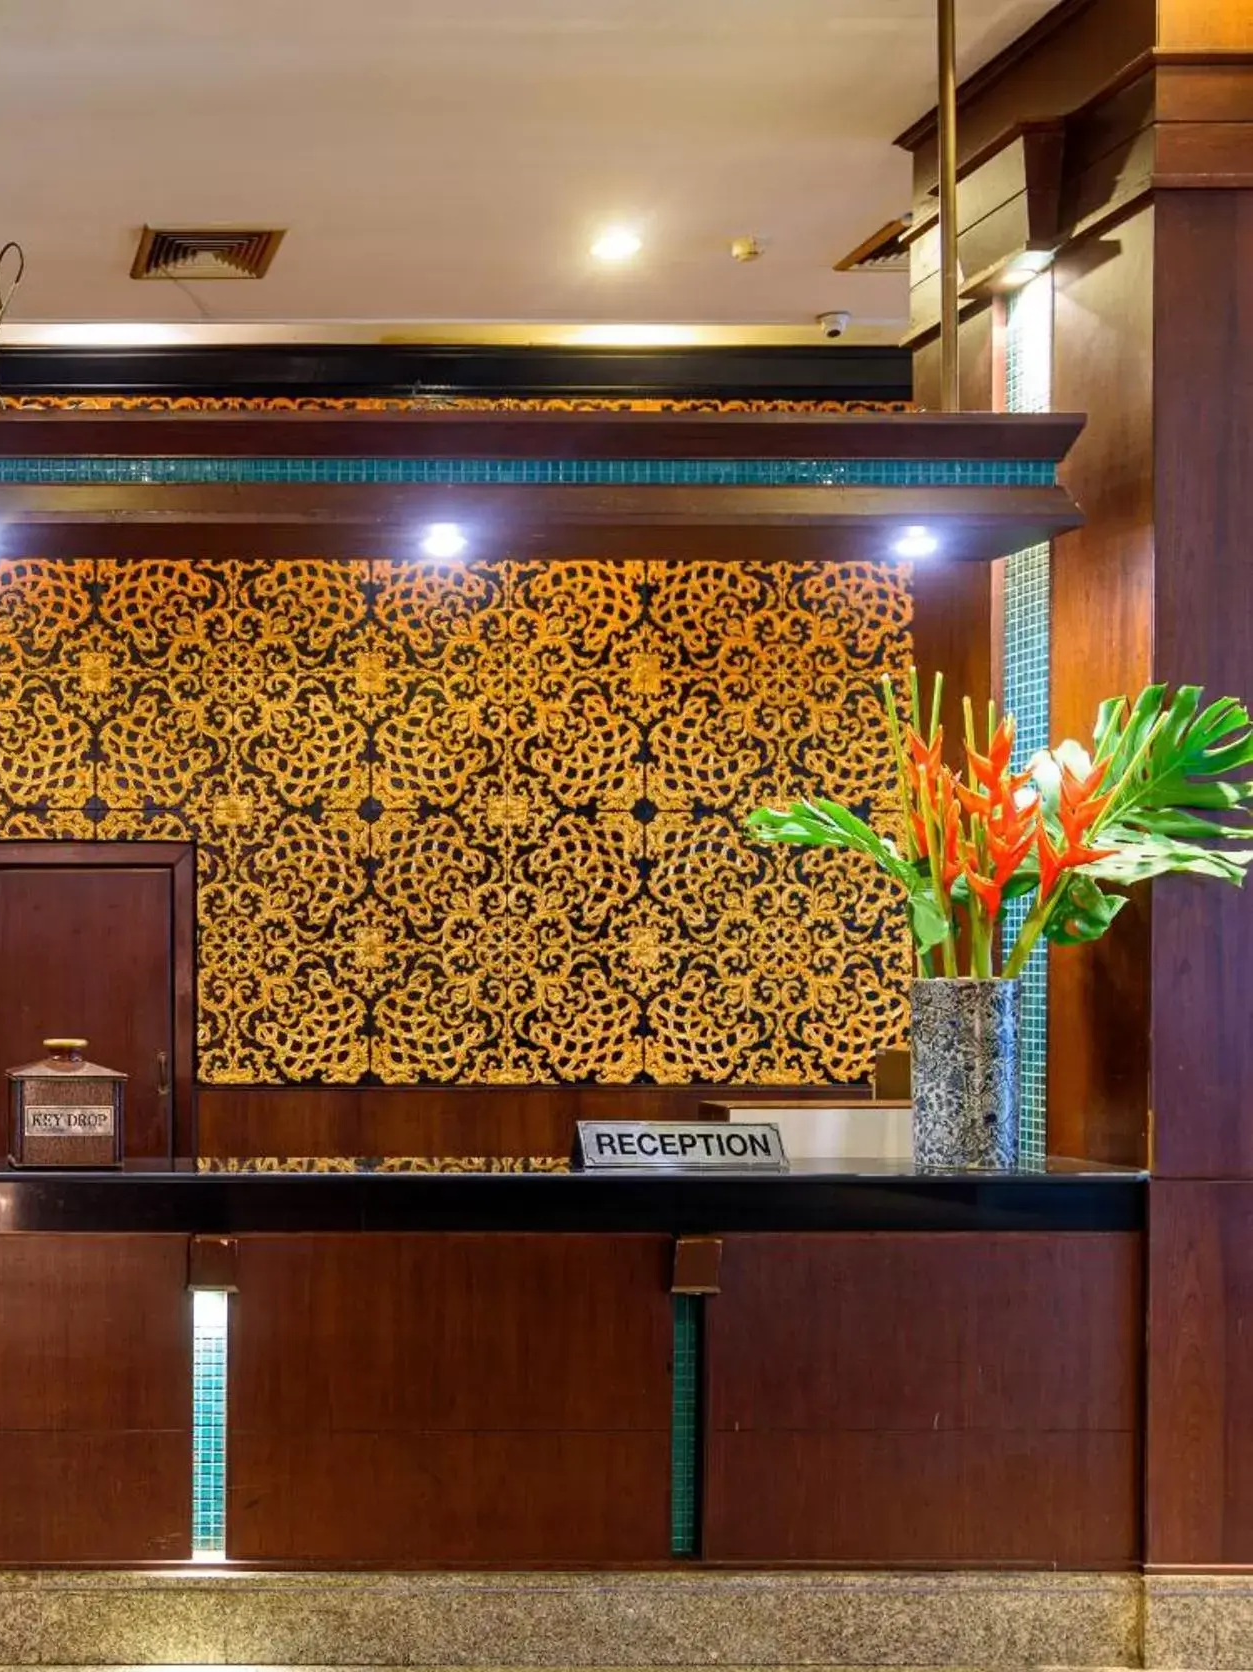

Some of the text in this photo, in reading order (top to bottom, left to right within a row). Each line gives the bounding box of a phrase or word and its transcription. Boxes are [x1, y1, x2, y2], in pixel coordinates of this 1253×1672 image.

[32, 1113, 108, 1127] KEY DROP
[594, 1133, 772, 1157] RECEPTION
